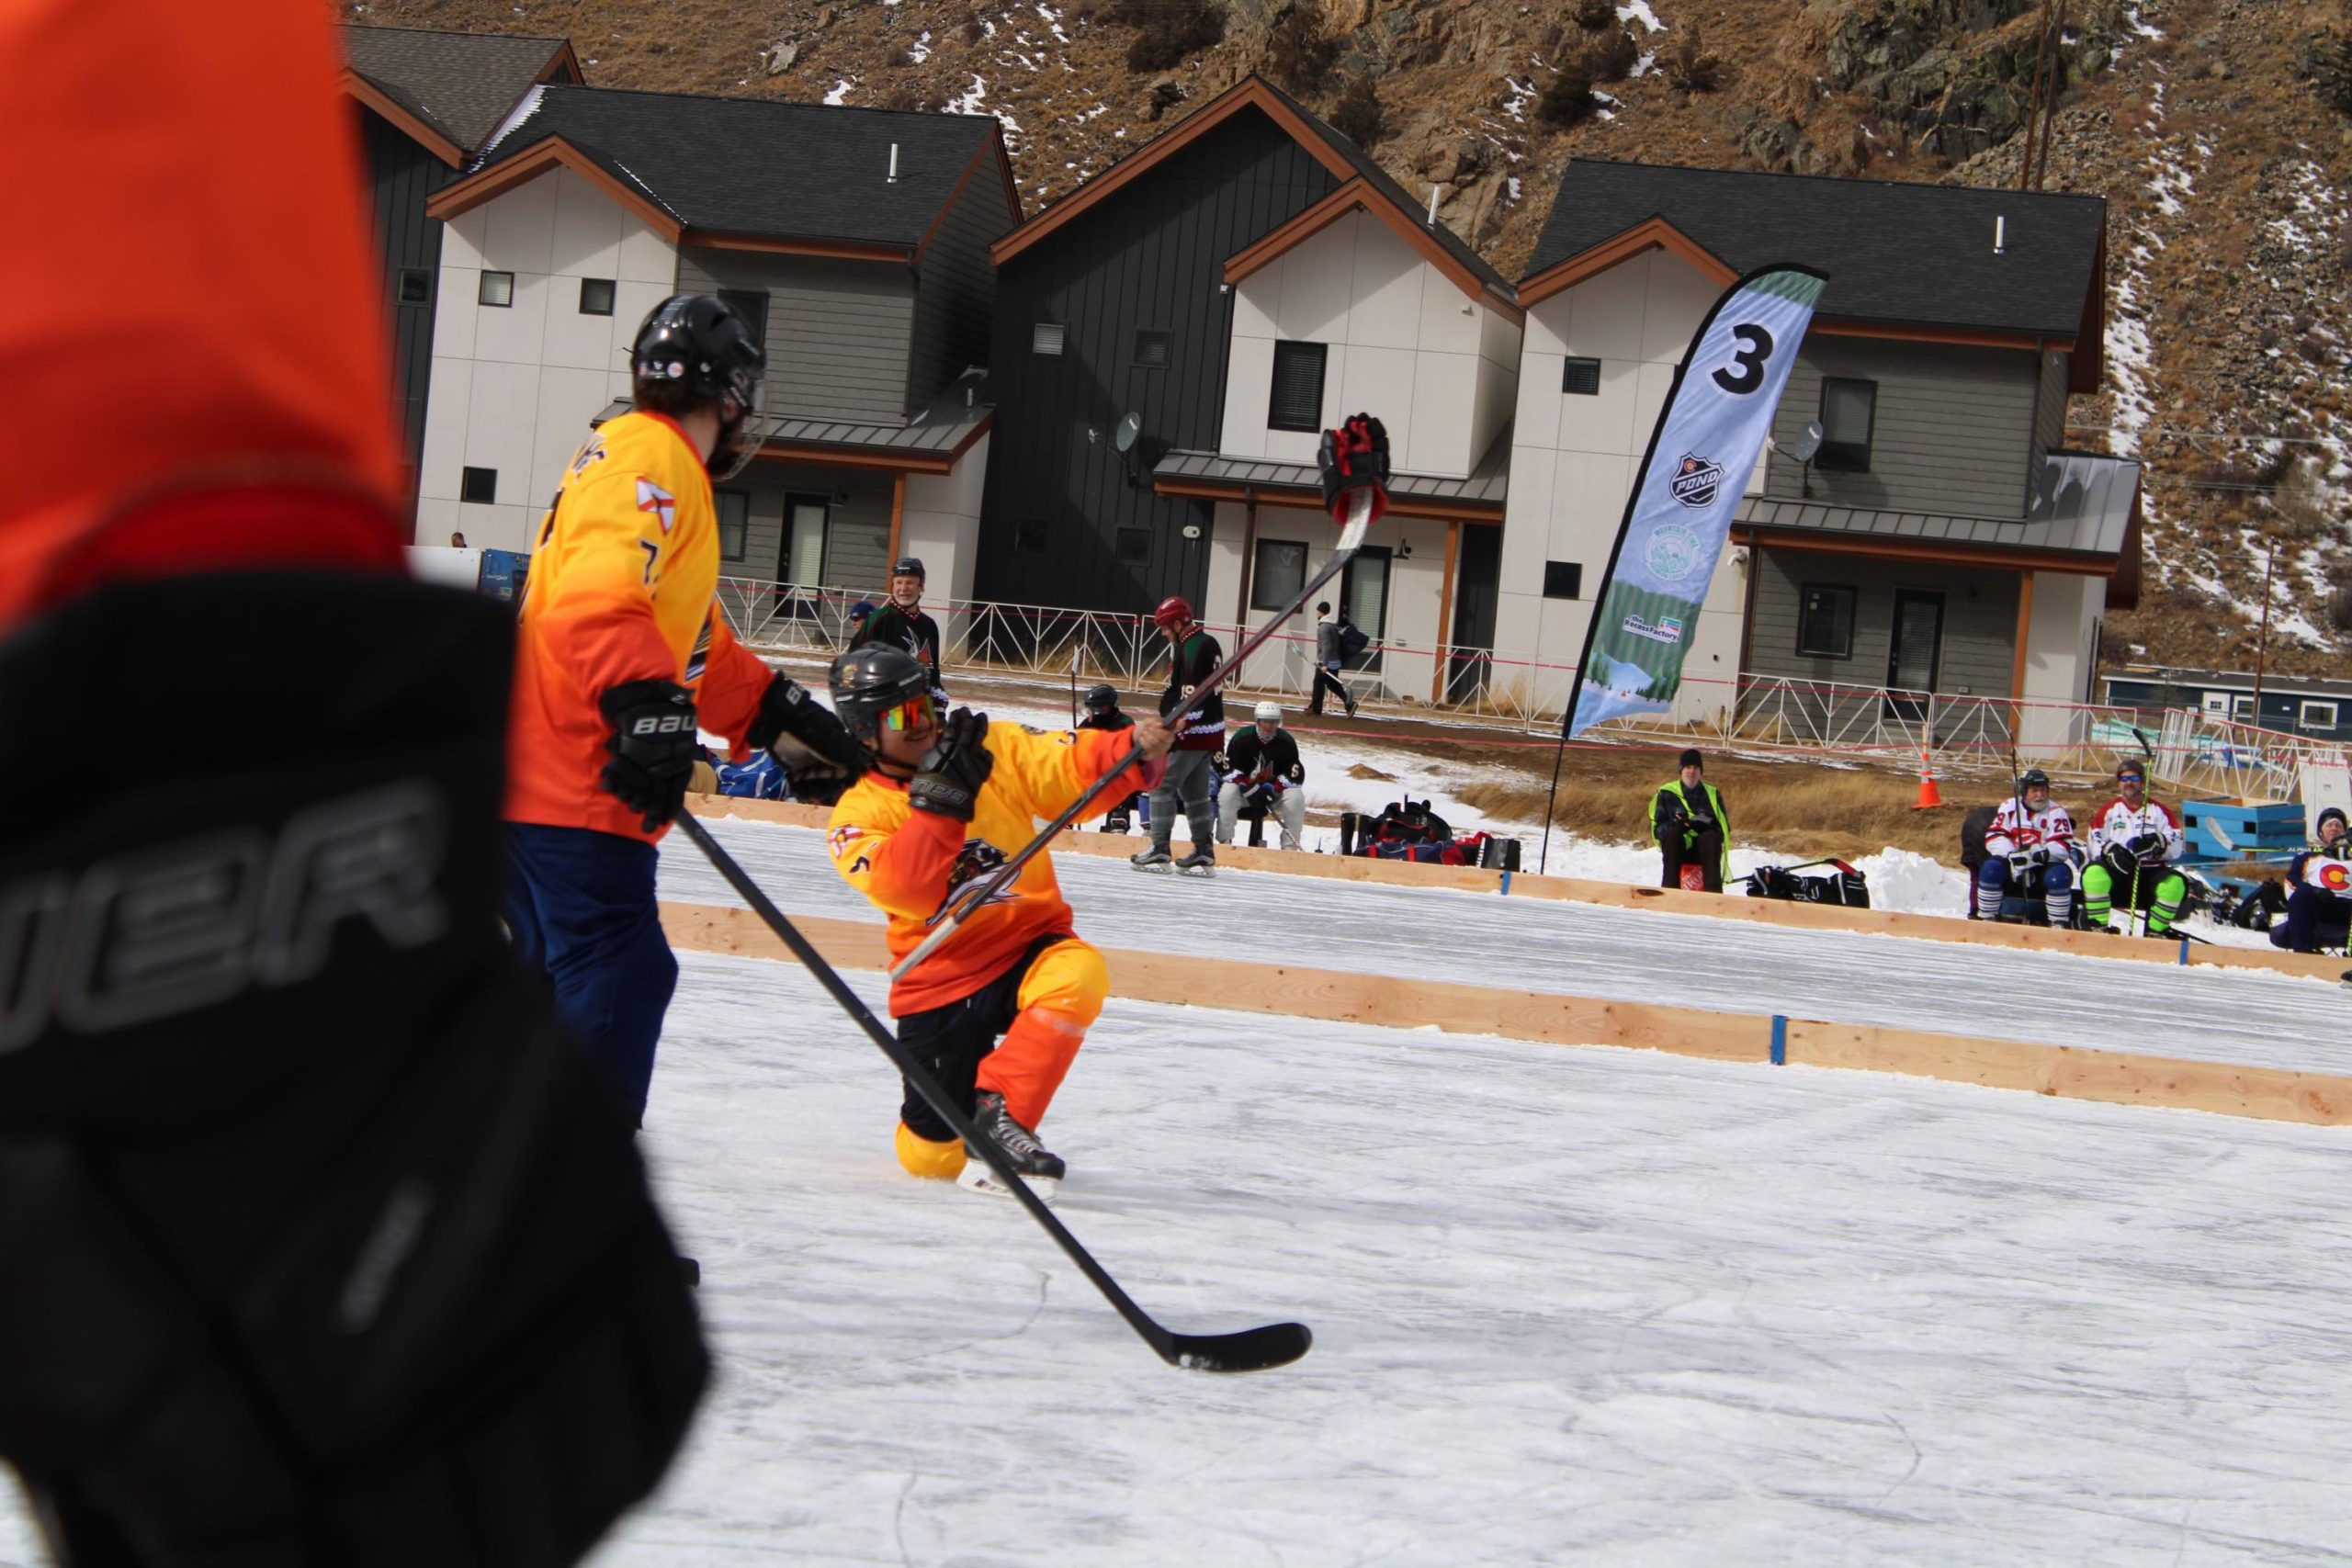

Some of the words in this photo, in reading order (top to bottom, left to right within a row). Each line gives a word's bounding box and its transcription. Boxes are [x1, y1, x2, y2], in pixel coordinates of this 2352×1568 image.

[1712, 323, 1773, 395] 3
[1676, 471, 1719, 494] POND
[2053, 818, 2070, 833] 29
